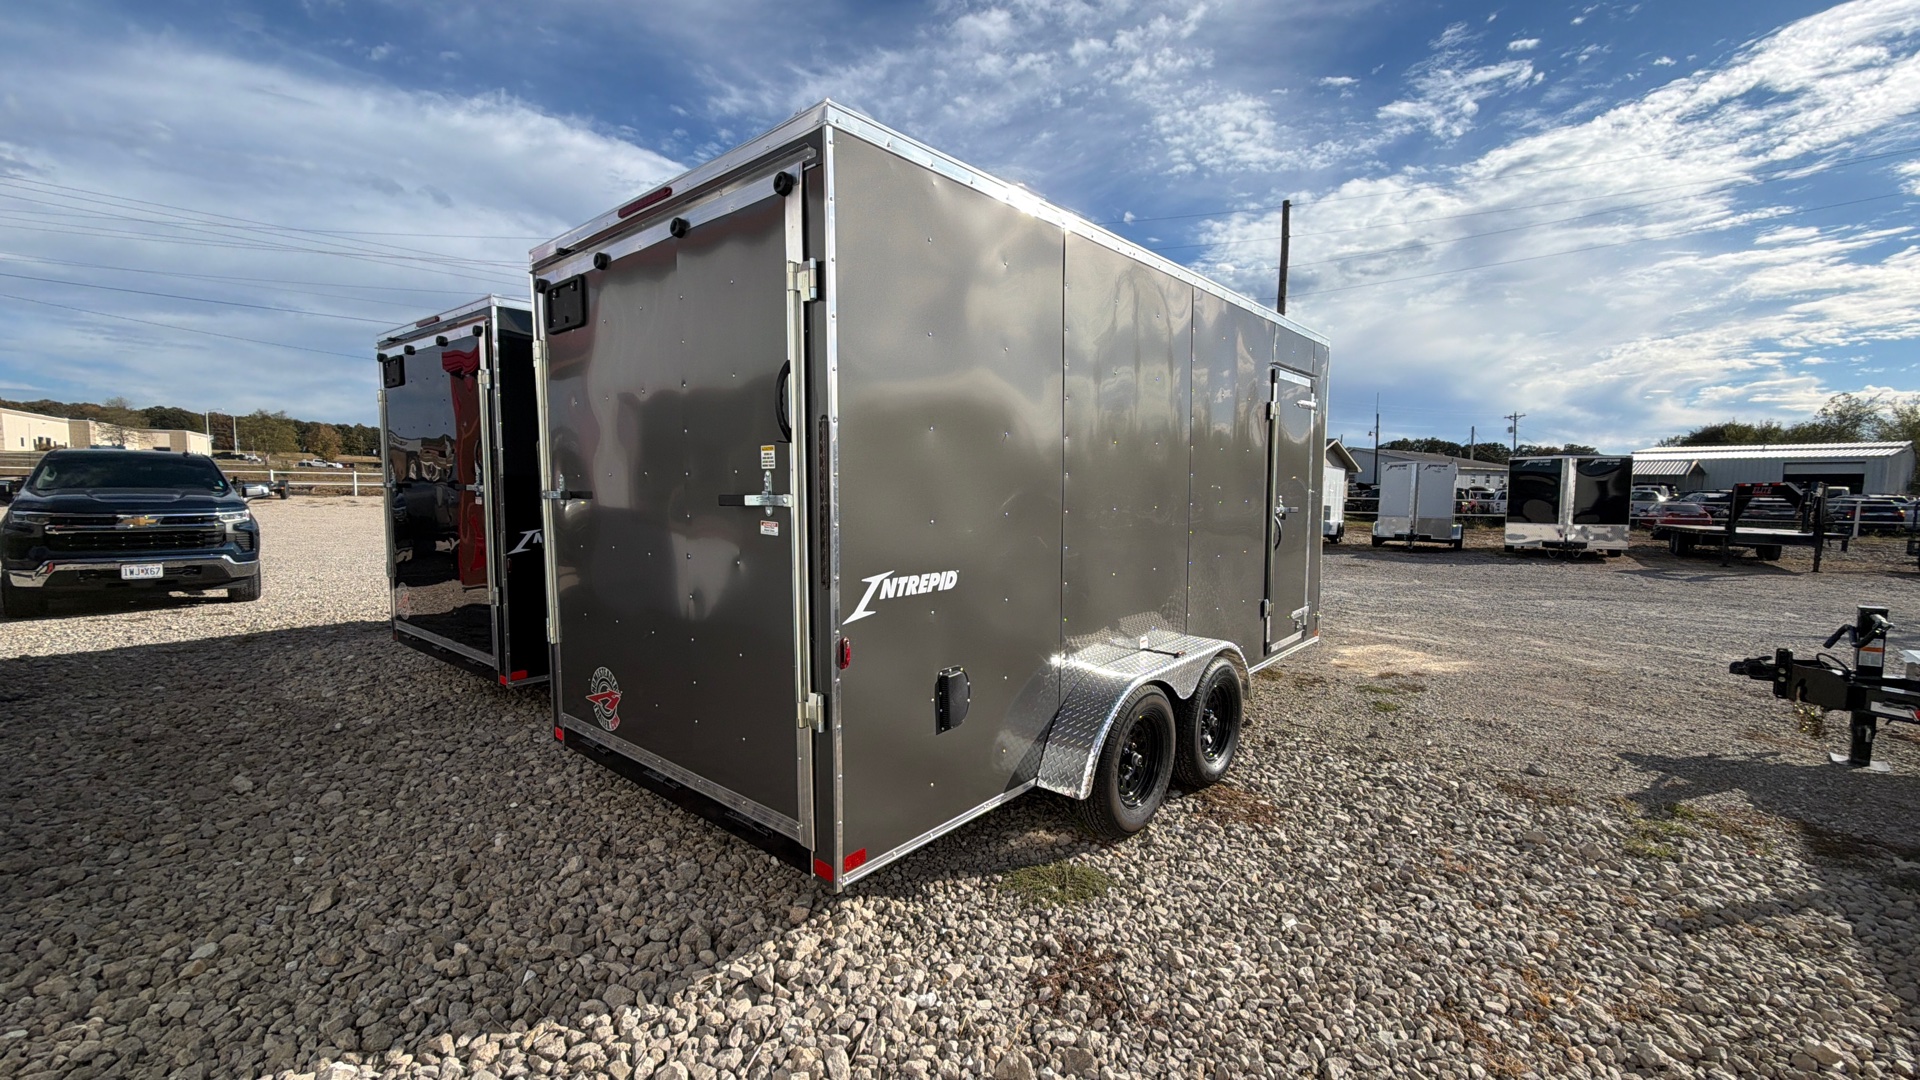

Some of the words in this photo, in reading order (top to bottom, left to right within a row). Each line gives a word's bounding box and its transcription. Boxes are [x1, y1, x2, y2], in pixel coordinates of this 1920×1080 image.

[1751, 486, 1773, 494] ELITE
[144, 567, 160, 576] X67
[842, 570, 959, 625] INTREPID
